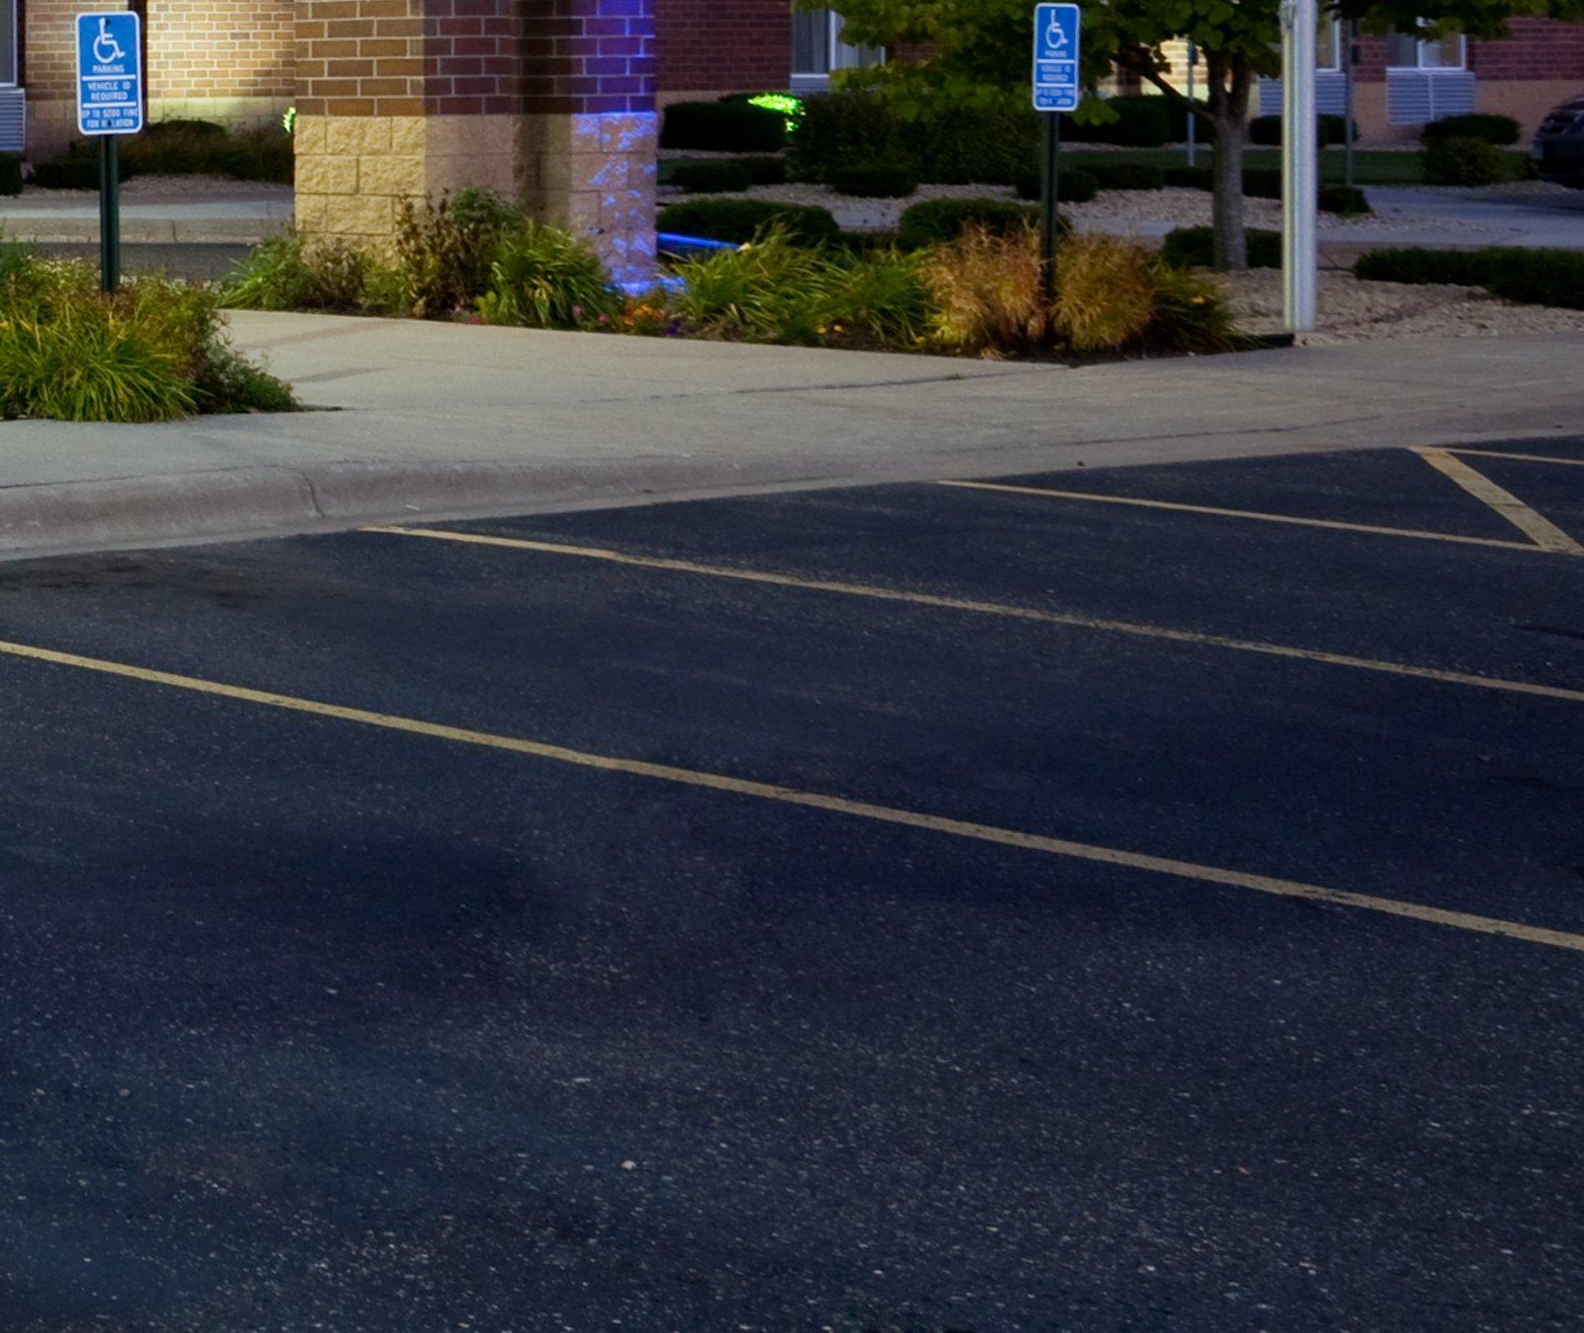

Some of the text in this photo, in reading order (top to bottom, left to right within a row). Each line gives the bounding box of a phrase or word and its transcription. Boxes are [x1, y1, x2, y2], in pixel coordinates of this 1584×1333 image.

[92, 64, 125, 73] PARKING
[87, 81, 119, 91] VEHICLE
[90, 91, 128, 101] REQUIRED
